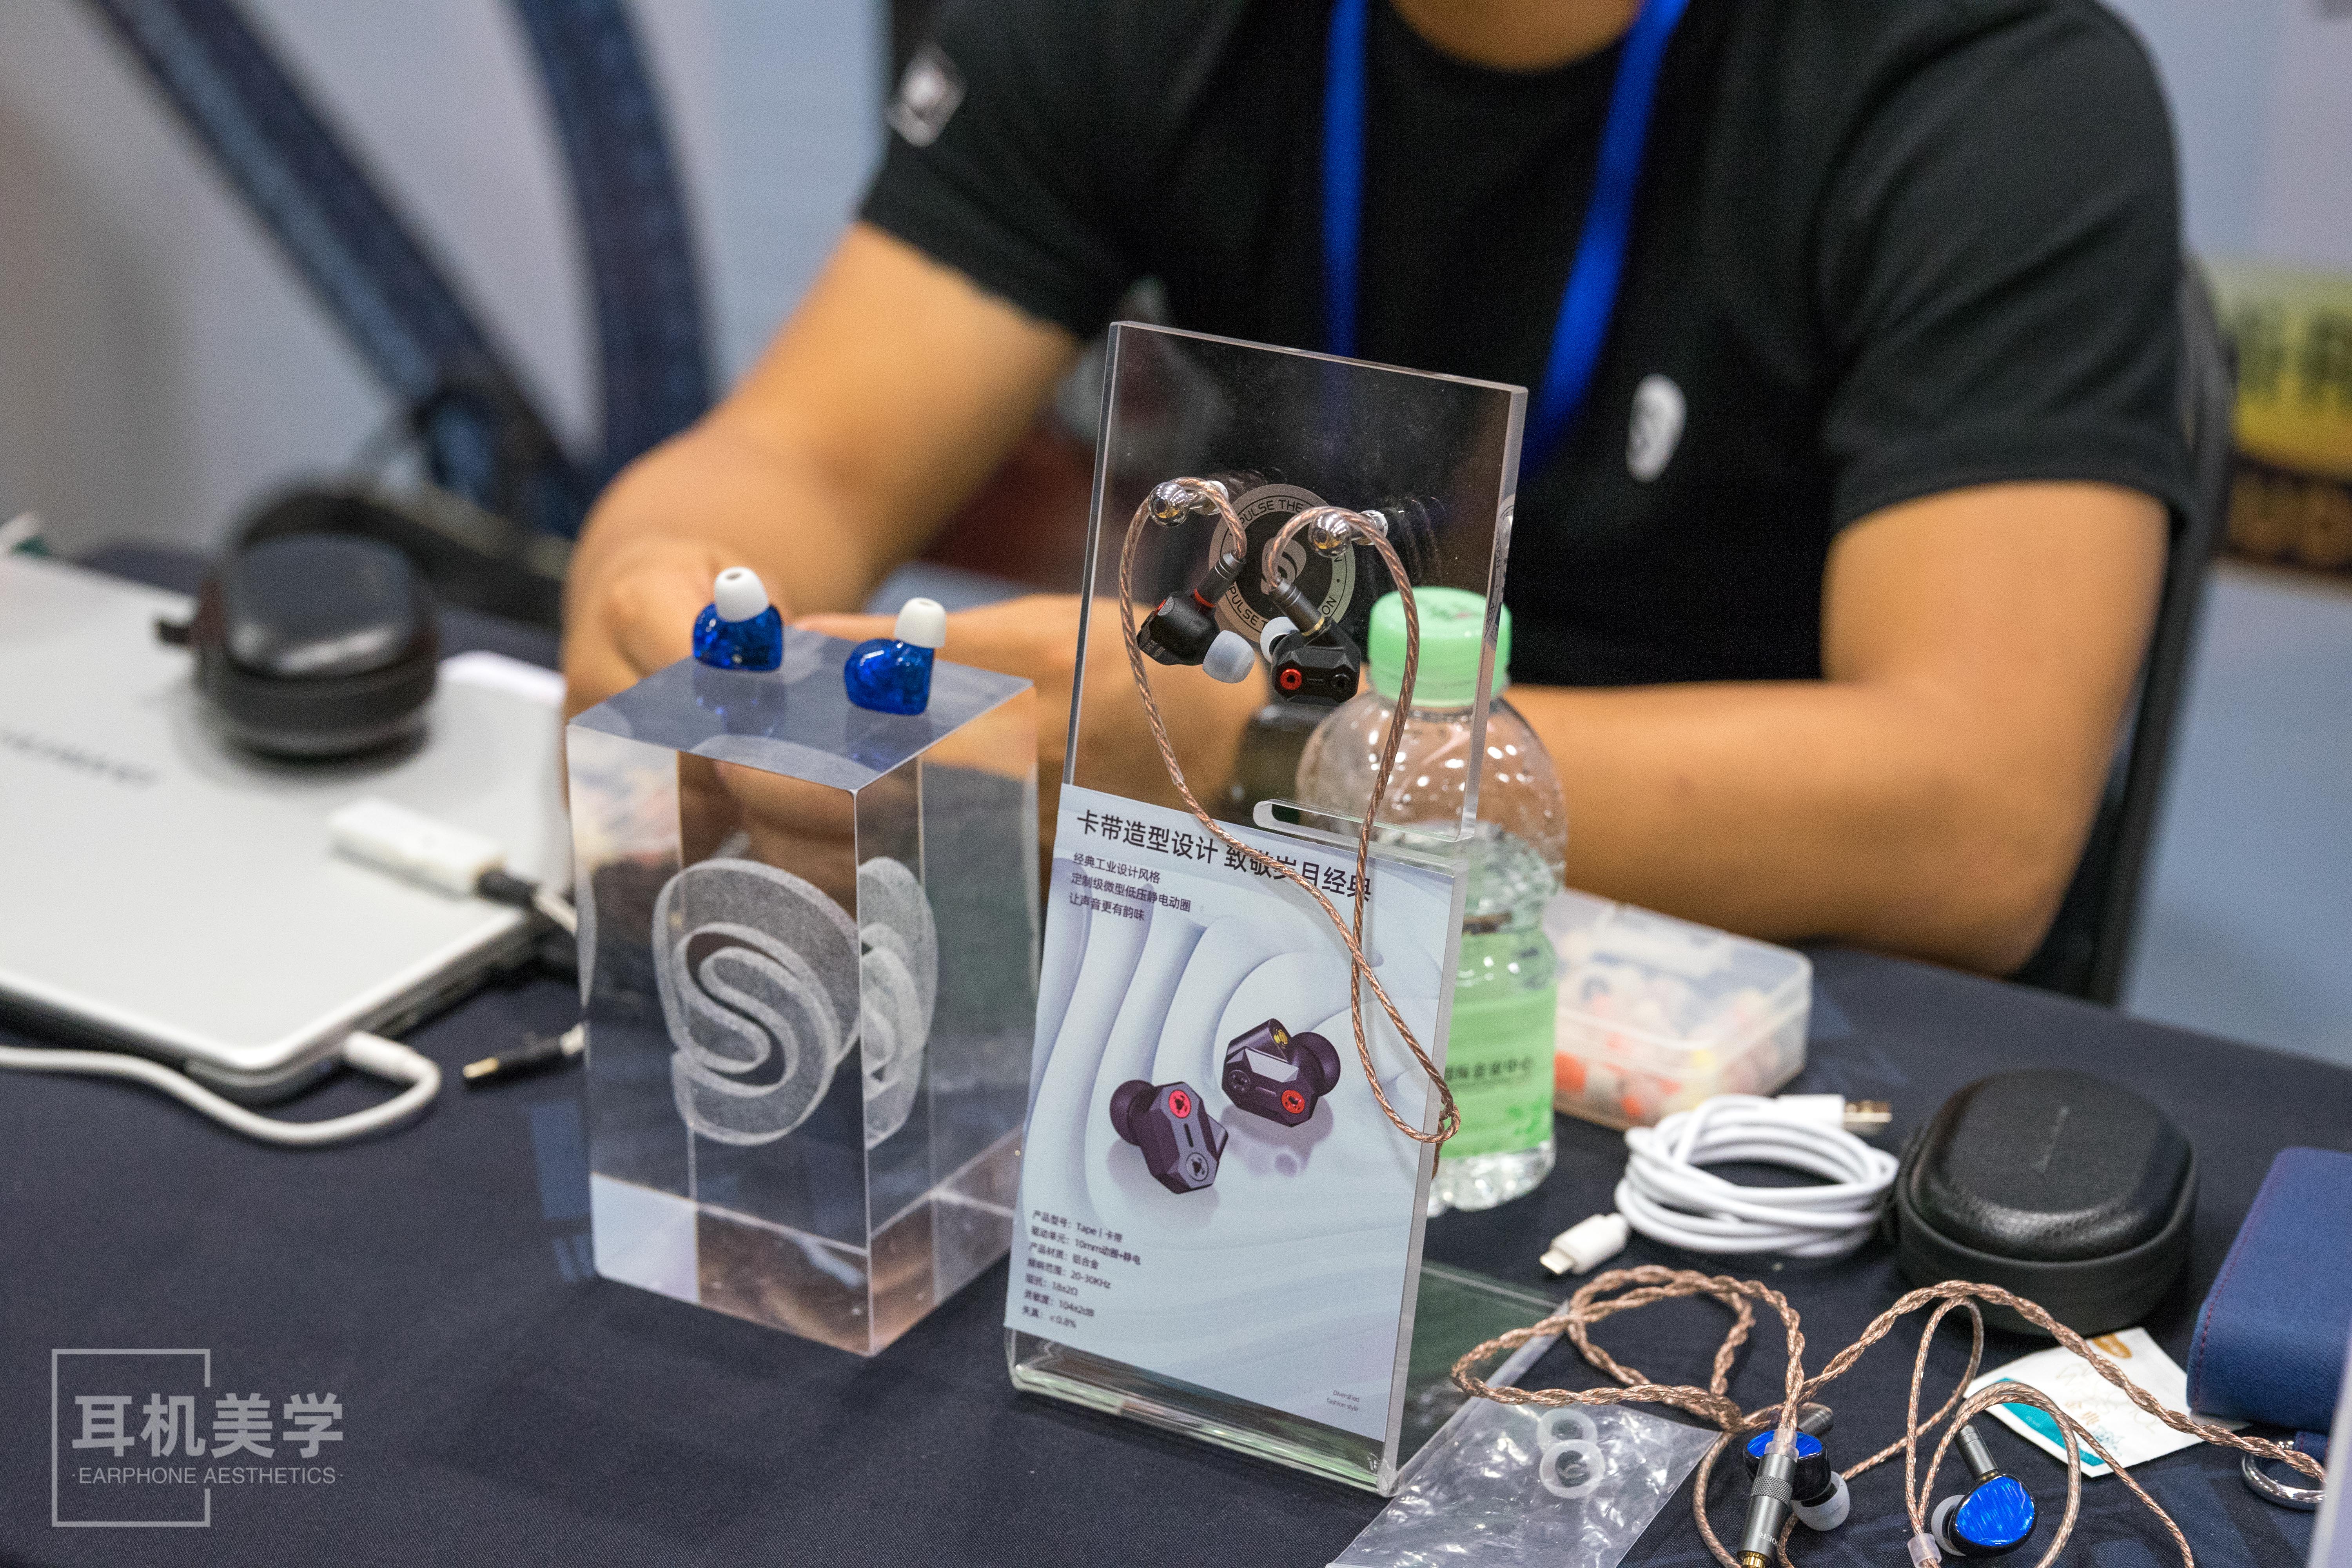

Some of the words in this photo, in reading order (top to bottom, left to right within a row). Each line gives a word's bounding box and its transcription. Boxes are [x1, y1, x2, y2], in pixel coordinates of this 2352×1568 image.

[1278, 499, 1304, 513] THE
[1076, 809, 1218, 864] 卡带造型设计
[1073, 852, 1161, 884] 经典工业设计风格
[1069, 892, 1145, 921] 让声音更有韵味
[1071, 872, 1191, 913] 定制级微型低压静电动圈
